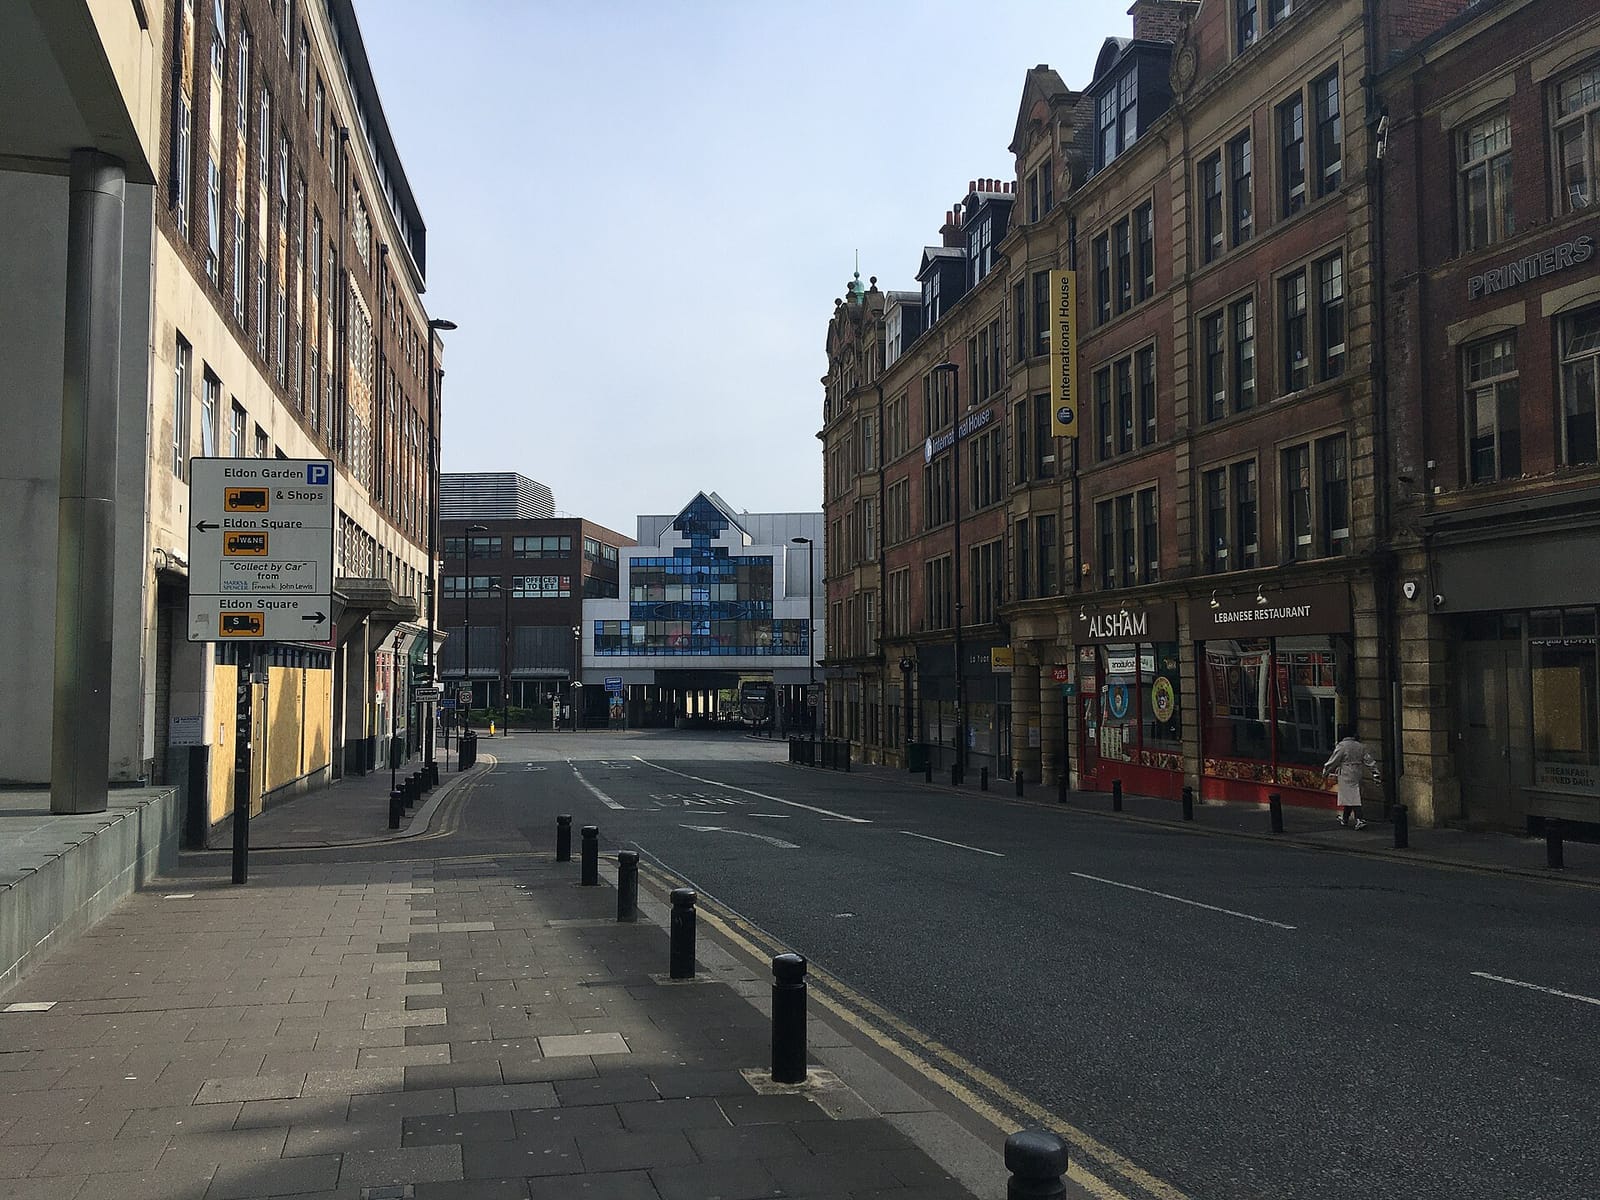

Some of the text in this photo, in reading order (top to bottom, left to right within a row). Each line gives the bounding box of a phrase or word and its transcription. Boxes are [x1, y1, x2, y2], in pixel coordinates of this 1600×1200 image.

[1467, 235, 1594, 301] PRINTERS
[1059, 277, 1071, 401] International House
[932, 409, 992, 455] Internatnal House
[224, 466, 326, 483] Eldon Garden P
[275, 490, 324, 501] & Shops
[223, 518, 303, 530] Eldon Square
[270, 562, 282, 572] by
[257, 572, 280, 580] from
[279, 582, 313, 591] John Lewis
[219, 599, 299, 610] Eldon Square
[1214, 605, 1311, 623] LEBANESE RESTAURANT
[232, 617, 240, 625] S
[1088, 611, 1147, 638] ALSHAM
